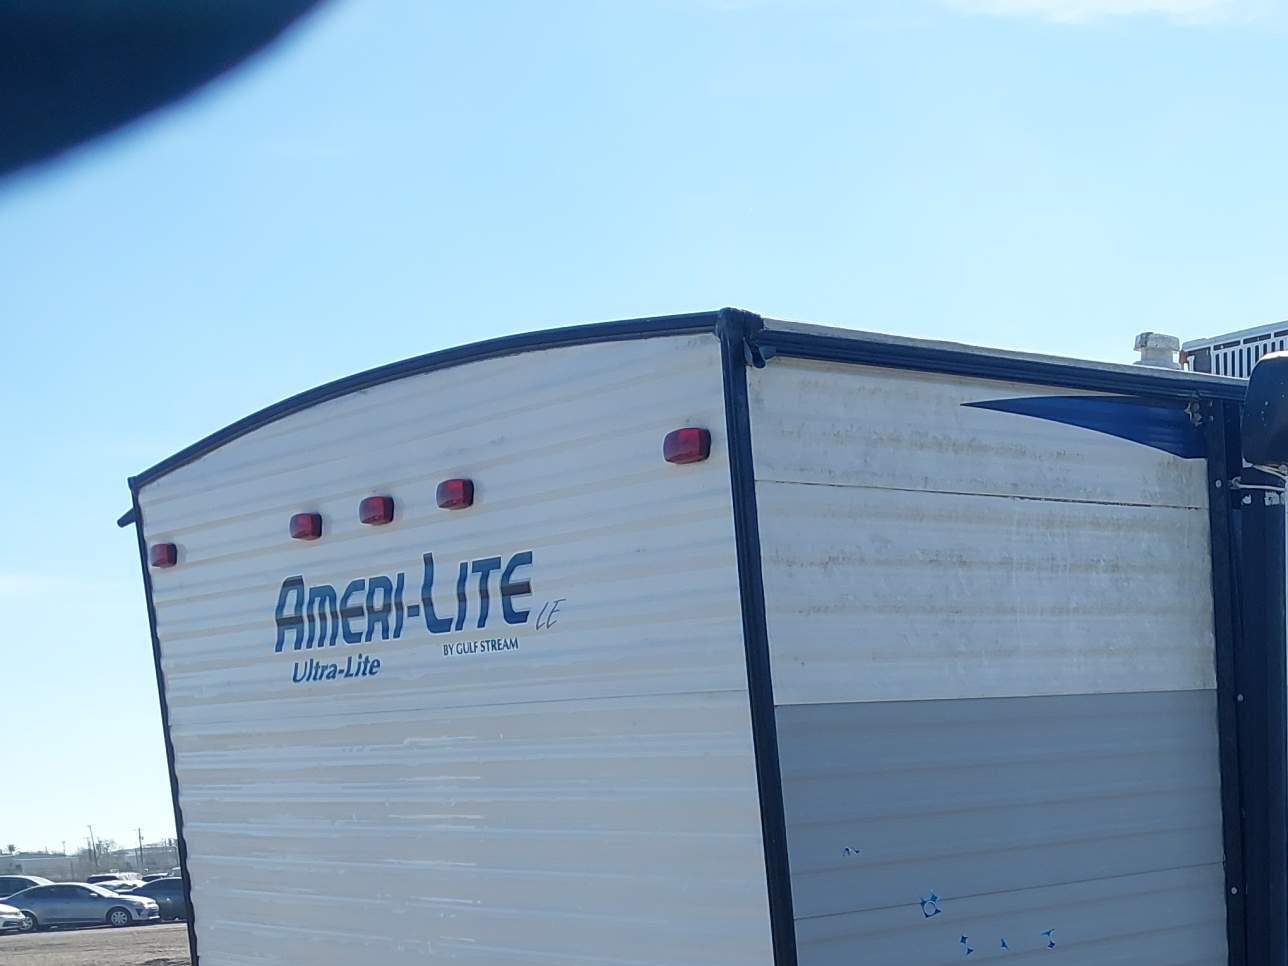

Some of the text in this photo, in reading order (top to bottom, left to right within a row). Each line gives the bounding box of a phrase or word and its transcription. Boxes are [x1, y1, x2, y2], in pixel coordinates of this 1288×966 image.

[443, 636, 520, 656] BY GULF STREAM
[292, 652, 381, 684] Ultra-Lite
